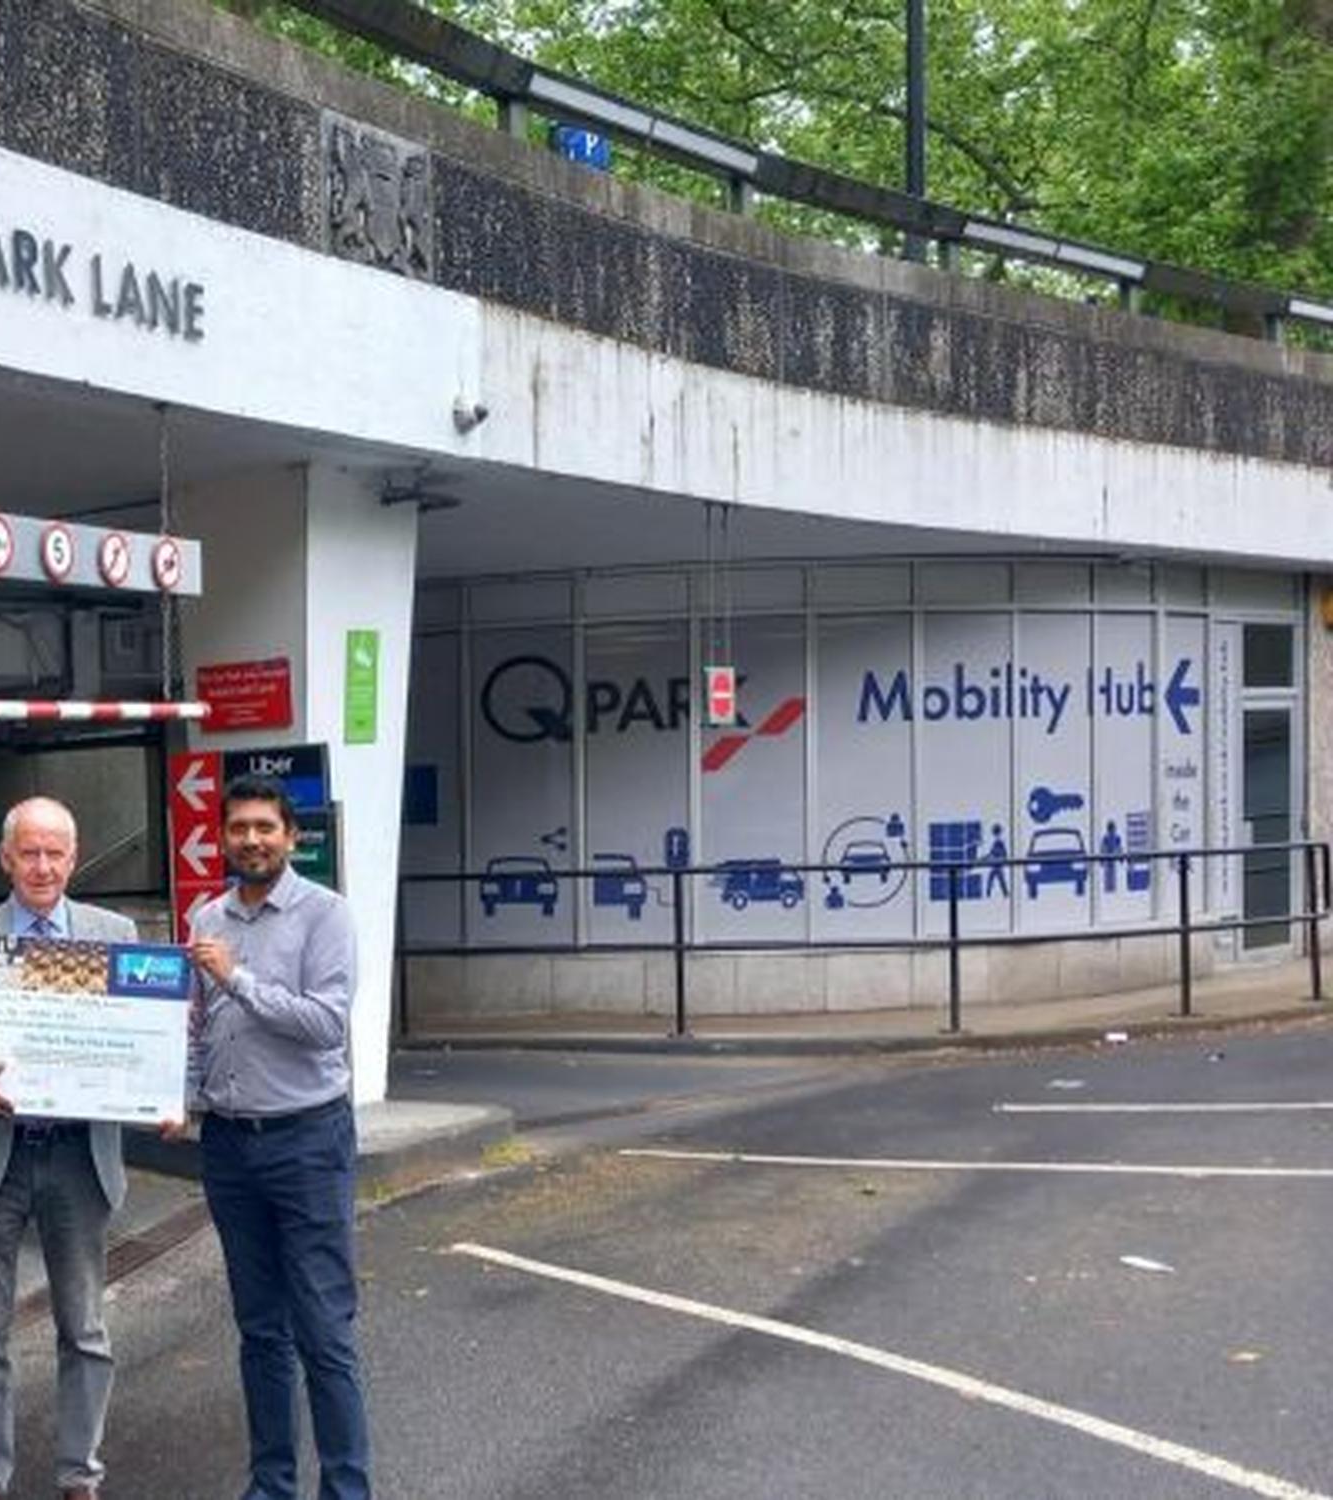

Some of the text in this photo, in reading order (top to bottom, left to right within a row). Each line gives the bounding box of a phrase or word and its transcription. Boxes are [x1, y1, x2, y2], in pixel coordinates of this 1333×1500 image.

[90, 253, 205, 342] LANE
[52, 537, 65, 565] 5
[857, 662, 1070, 734] Mobility
[1087, 661, 1156, 717] Hub
[249, 755, 294, 776] Uber
